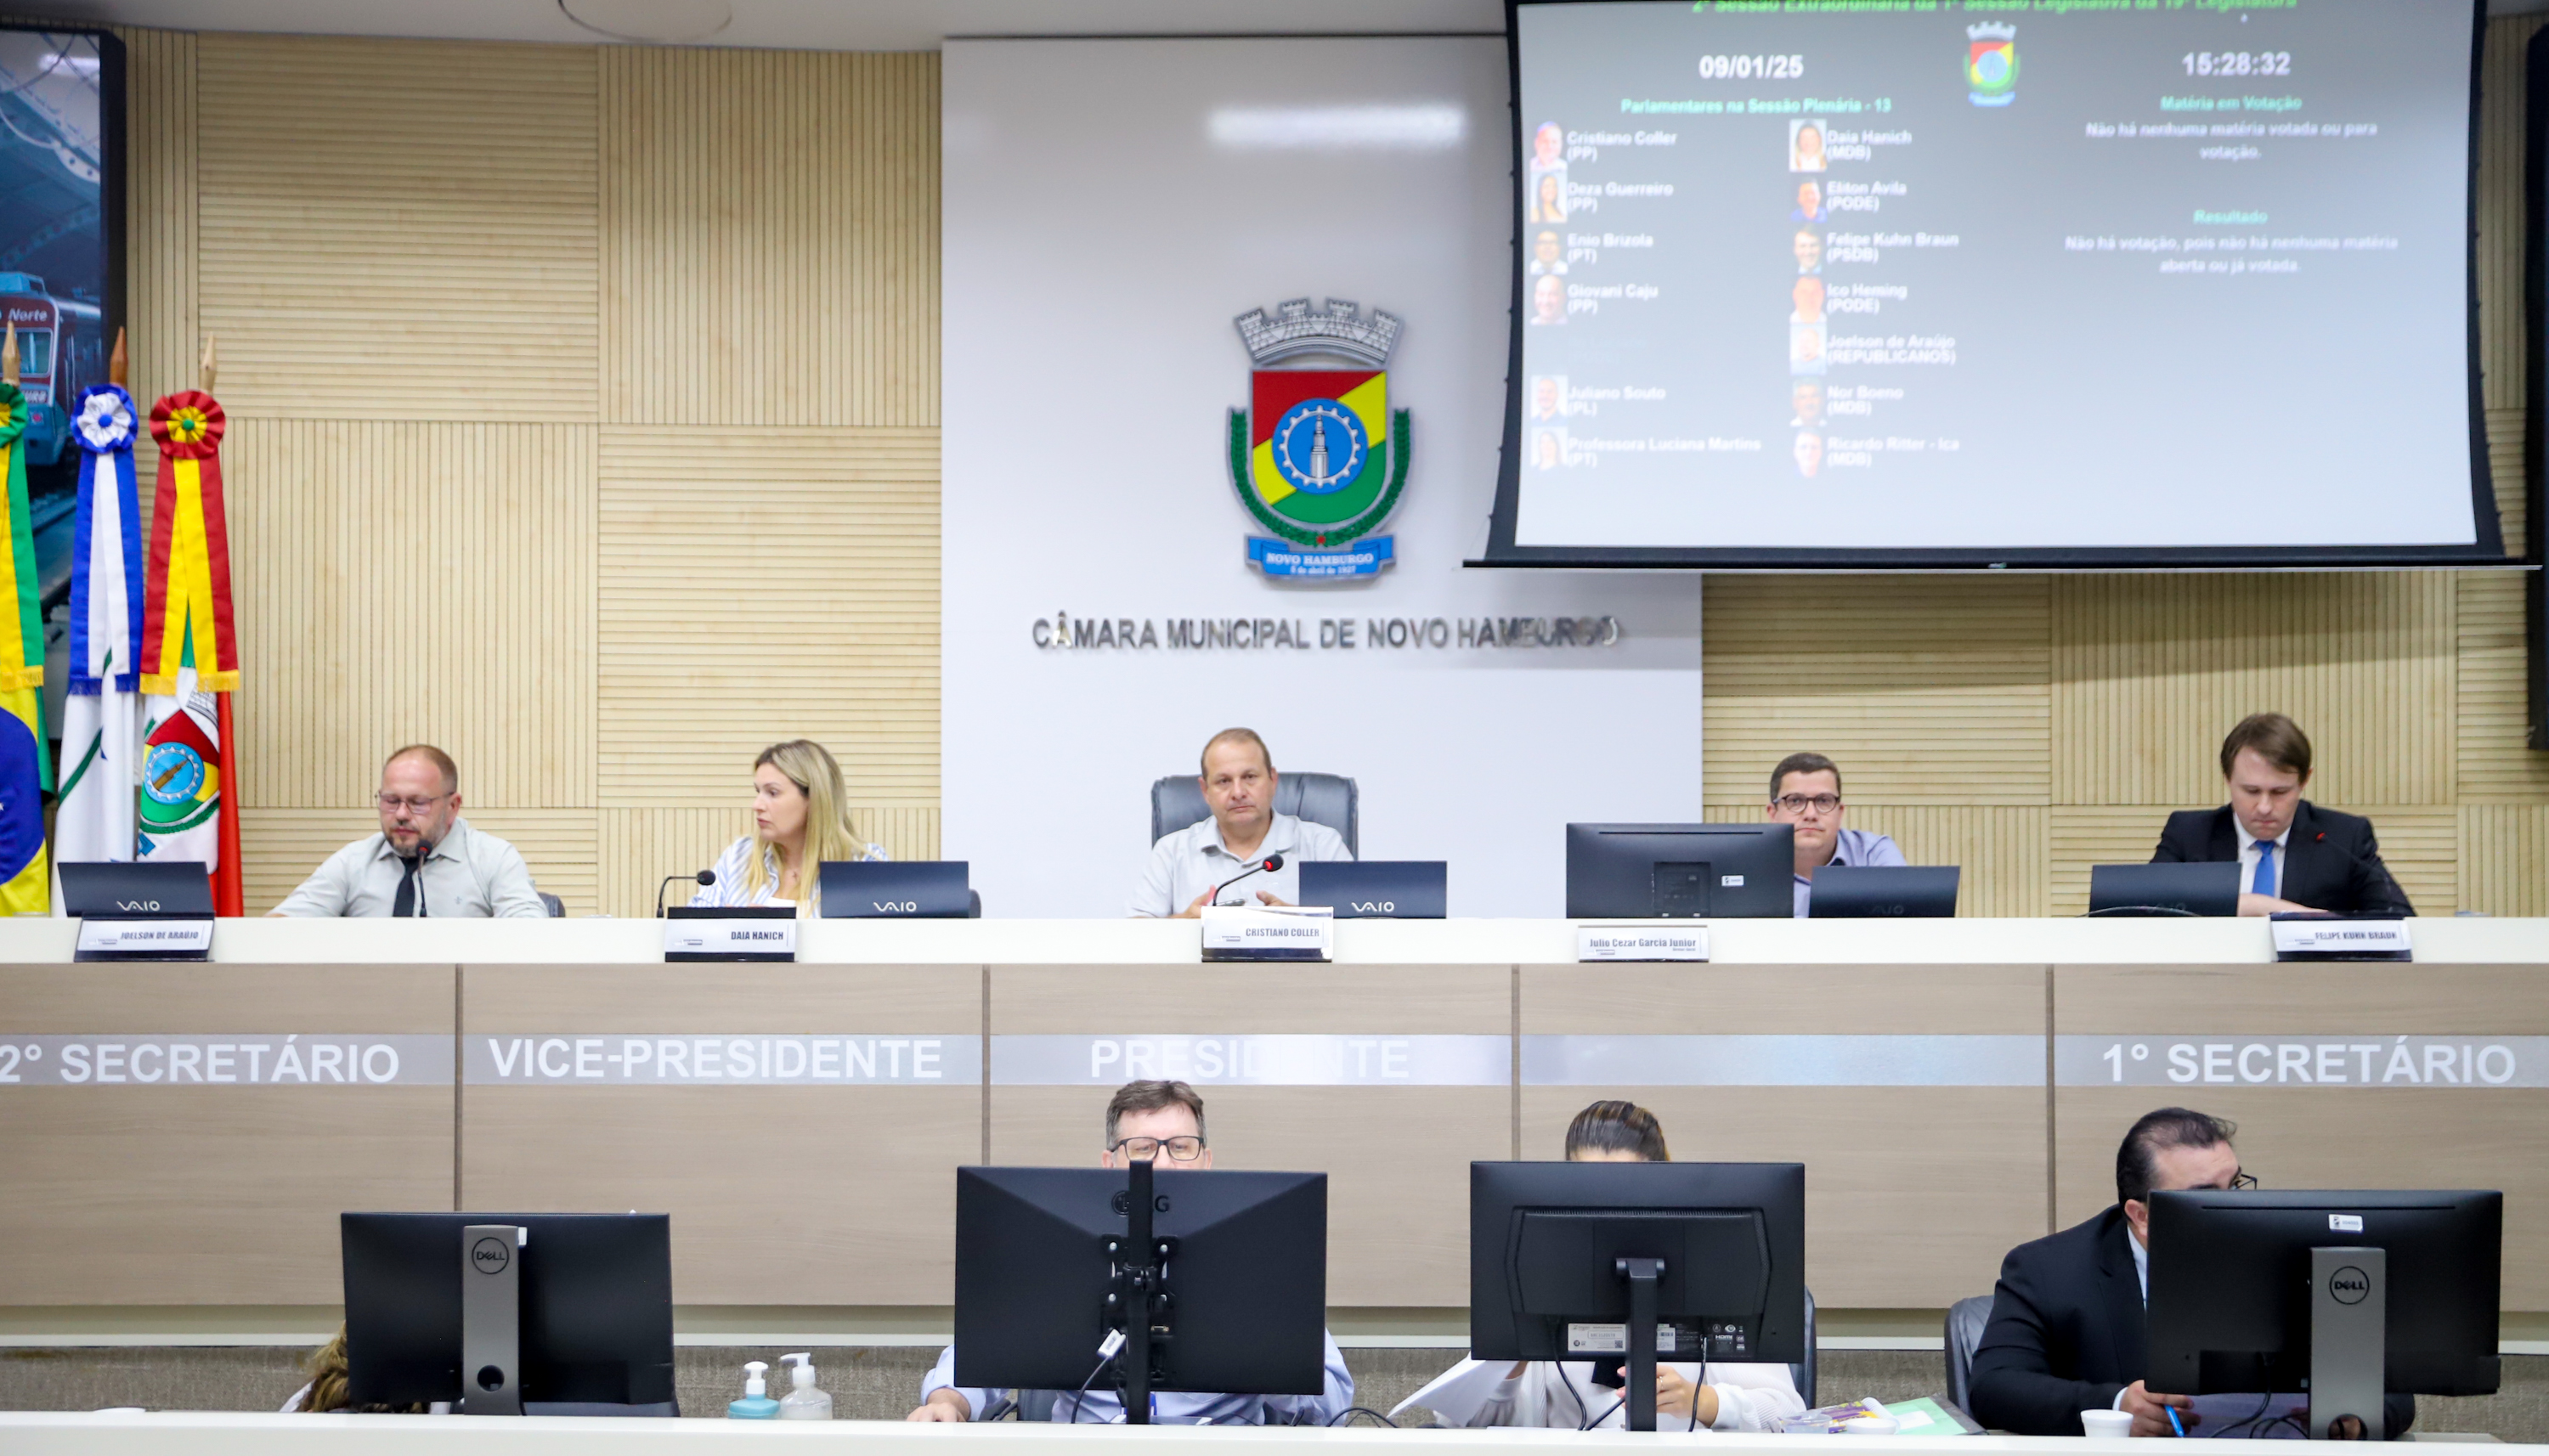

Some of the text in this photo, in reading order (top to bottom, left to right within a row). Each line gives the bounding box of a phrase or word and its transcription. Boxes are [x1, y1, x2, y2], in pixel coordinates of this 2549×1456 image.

[1698, 54, 1804, 78] 09/01/25
[2182, 52, 2292, 76] 15:28:32
[1621, 99, 1723, 114] Parlamentares
[1726, 100, 1744, 114] na
[1748, 99, 1800, 114] Sessão
[1803, 97, 1862, 114] Plenária
[1874, 98, 1892, 113] 13
[2160, 94, 2303, 113] Matéria em Votação
[1567, 130, 1678, 145] Cristiano Coller
[1827, 129, 1913, 144] Daia Hanich
[2085, 121, 2378, 139] Não há nenhuma matéria votada ou para
[1567, 145, 1597, 163] (PP)
[1827, 144, 1872, 162] (MDB)
[2199, 144, 2262, 161] votação.
[1567, 181, 1675, 196] Deza Guerreiro
[1567, 196, 1598, 214] (PP)
[1827, 196, 1879, 213] (PODE)
[2193, 209, 2269, 225] Resultado
[1567, 233, 1654, 248] Enio Brizola
[1827, 232, 1959, 249] Felipe Kuhn Braun
[2065, 234, 2399, 253] Não há votação, pois não há nenhuma matéria
[1567, 247, 1597, 265] (PT)
[1827, 247, 1879, 264] (PSDB)
[2159, 258, 2301, 276] aberta ou já votada.
[1568, 284, 1659, 301] Giovani Caju
[1827, 284, 1908, 301] Ico Heming
[8, 308, 48, 322] Norte
[1568, 298, 1598, 316] (PP)
[1827, 298, 1879, 315] (PODE)
[1827, 333, 1956, 350] Joelson de Araújo
[1827, 349, 1957, 366] (REPUBLICANOS)
[1568, 386, 1666, 400] Juliano Souto
[1568, 401, 1597, 417] (PL)
[1827, 400, 1872, 416] (MDB)
[1568, 436, 1762, 451] Professora Luciana Martins
[1827, 436, 1884, 451] Ricardo
[1568, 452, 1598, 469] (PT)
[1266, 552, 1374, 565] NOVO HAMBURGO
[1032, 609, 1619, 649] CÂMARA MUNICIPAL DE NOVO HAMBURGO
[116, 900, 161, 911] VAIO
[873, 901, 917, 912] VAIO
[1351, 901, 1395, 912] VAIO
[731, 931, 784, 940] DAIA HANICH
[1246, 928, 1320, 937] CRISTIANO COLLER
[1590, 938, 1697, 947] Julio Cezar Garcia Junior
[60, 1034, 399, 1085] SECRETÁRIO
[488, 1038, 942, 1080] VICE-PRESIDENTE
[2166, 1034, 2517, 1085] SECRETÁRIO
[477, 1251, 505, 1261] DELL
[2334, 1281, 2365, 1290] DELL
